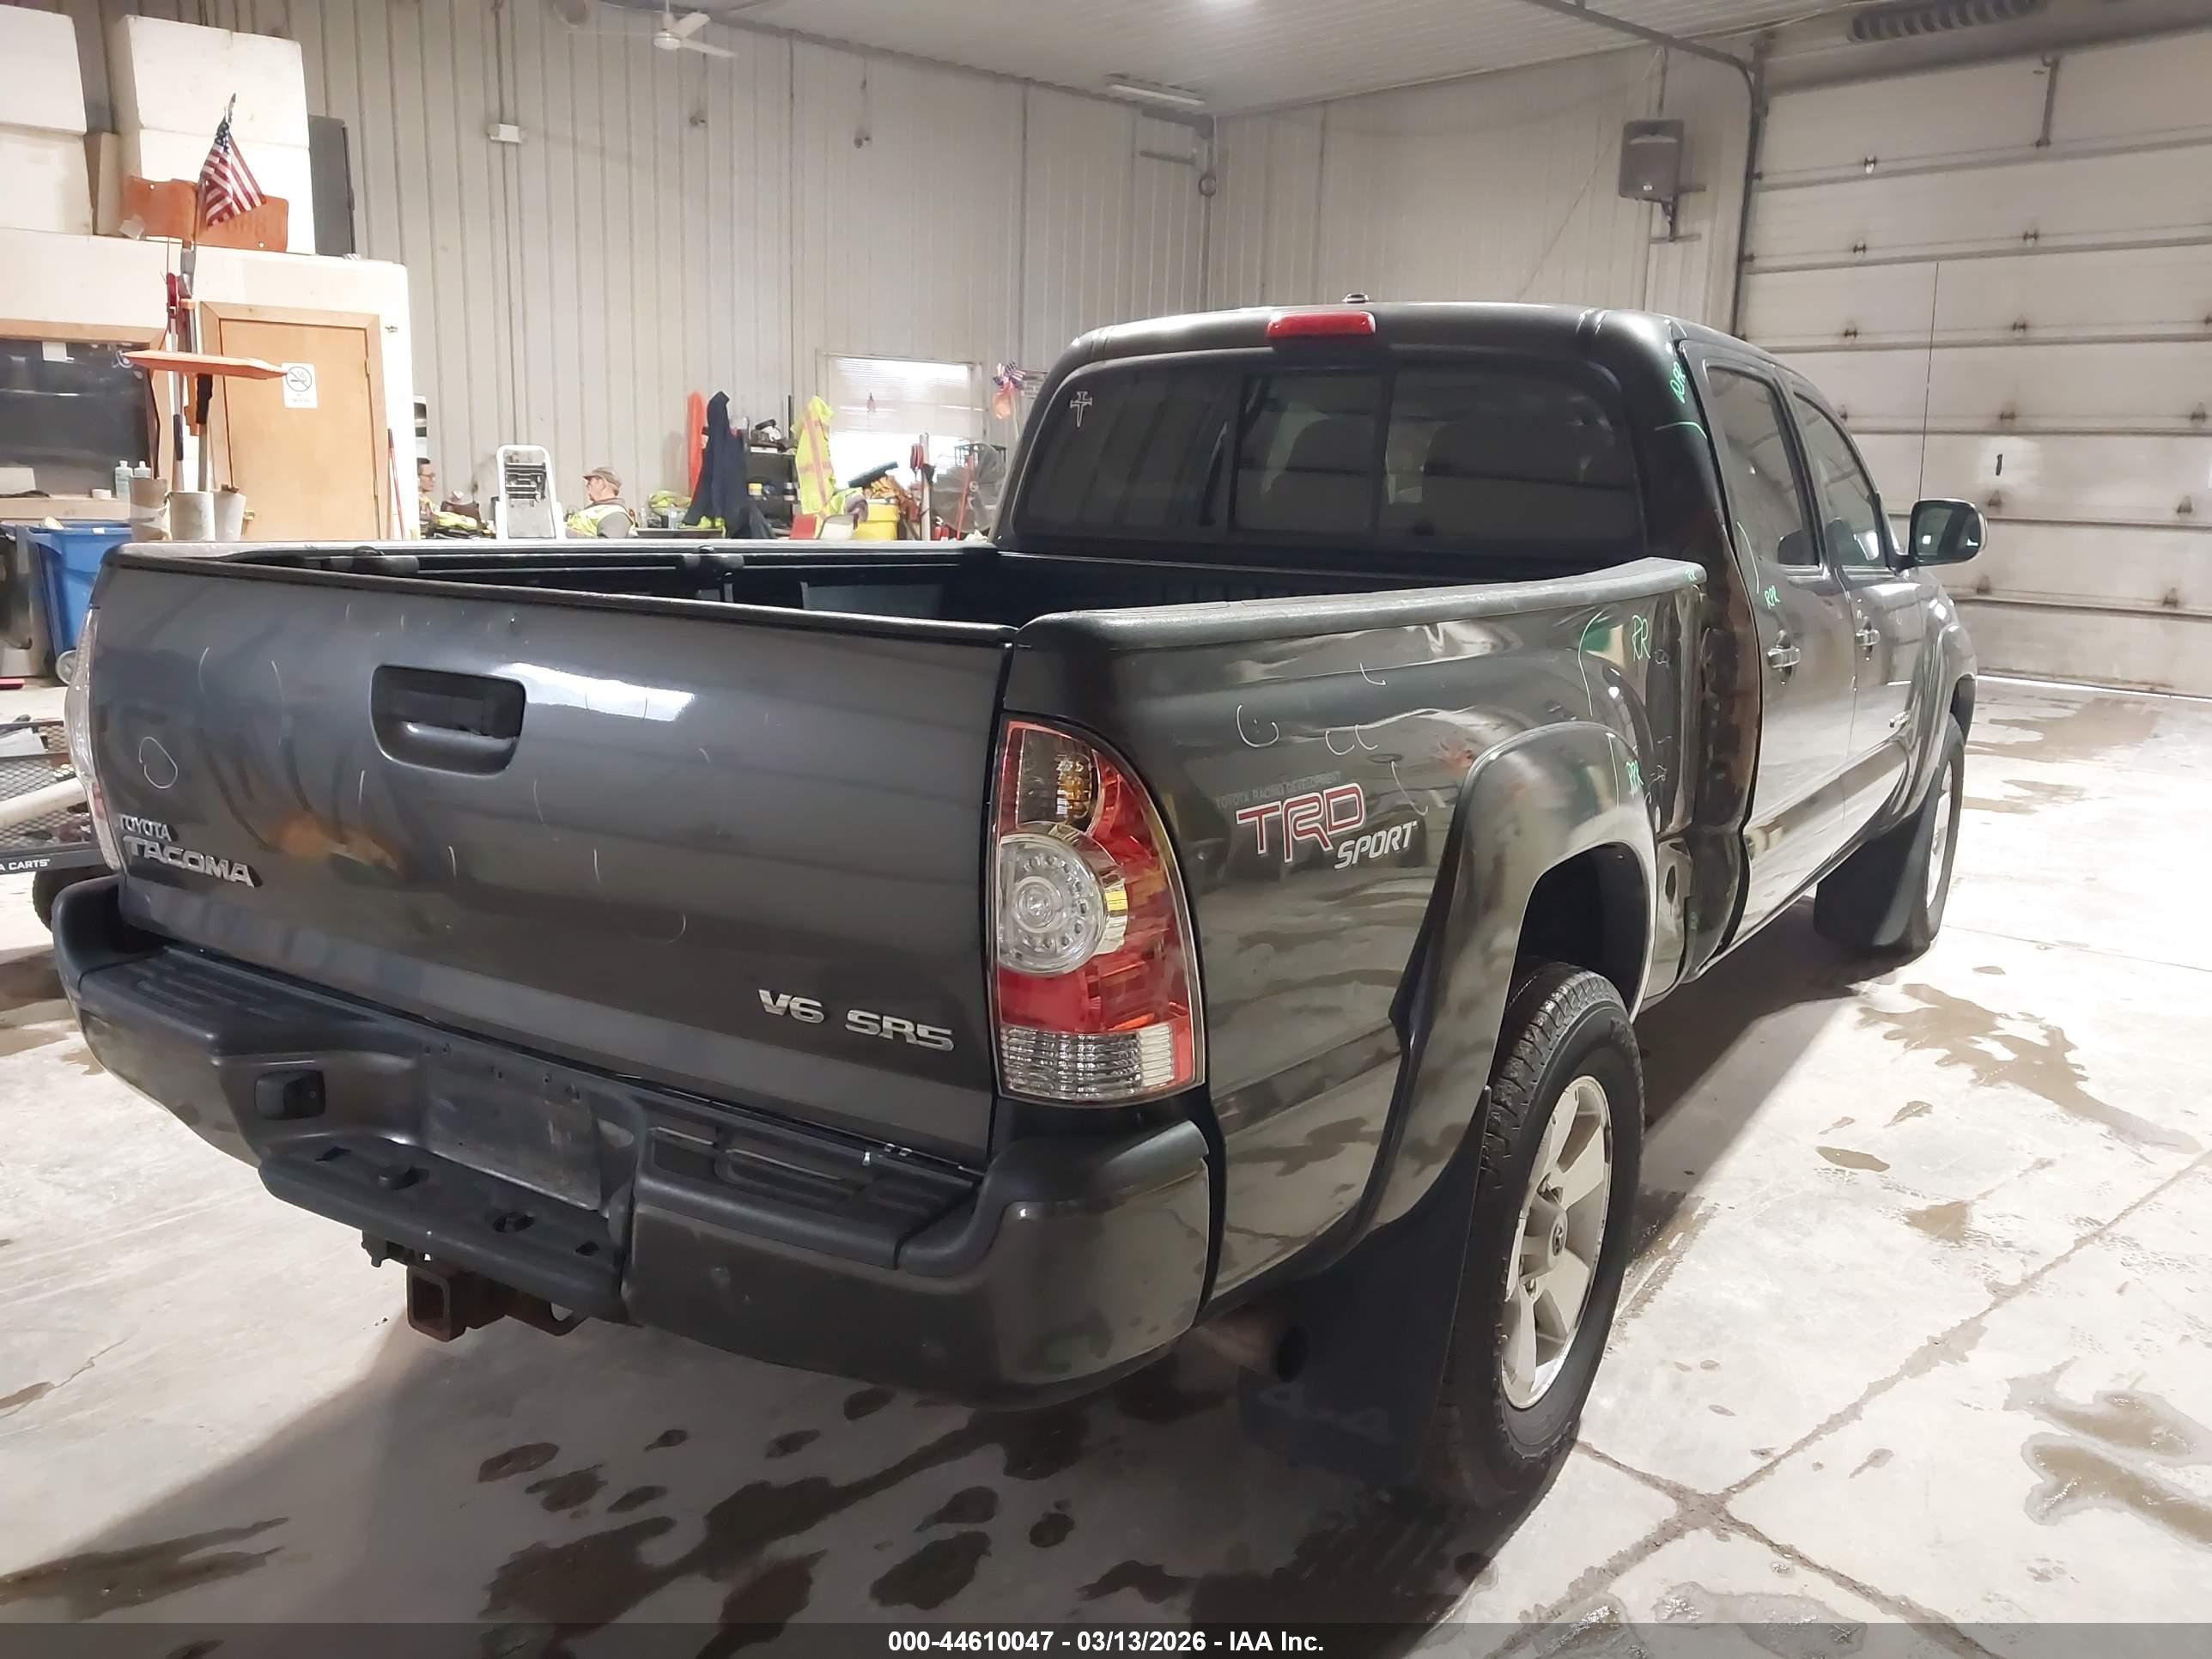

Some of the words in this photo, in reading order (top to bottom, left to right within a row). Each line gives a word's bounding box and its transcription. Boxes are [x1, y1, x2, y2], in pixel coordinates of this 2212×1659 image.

[118, 814, 172, 842] TOYOTA
[1236, 782, 1364, 863] TRD
[1334, 822, 1413, 870] SPORT
[123, 836, 255, 888] TACOMA
[758, 988, 825, 1024] V6
[845, 1009, 955, 1052] SR5
